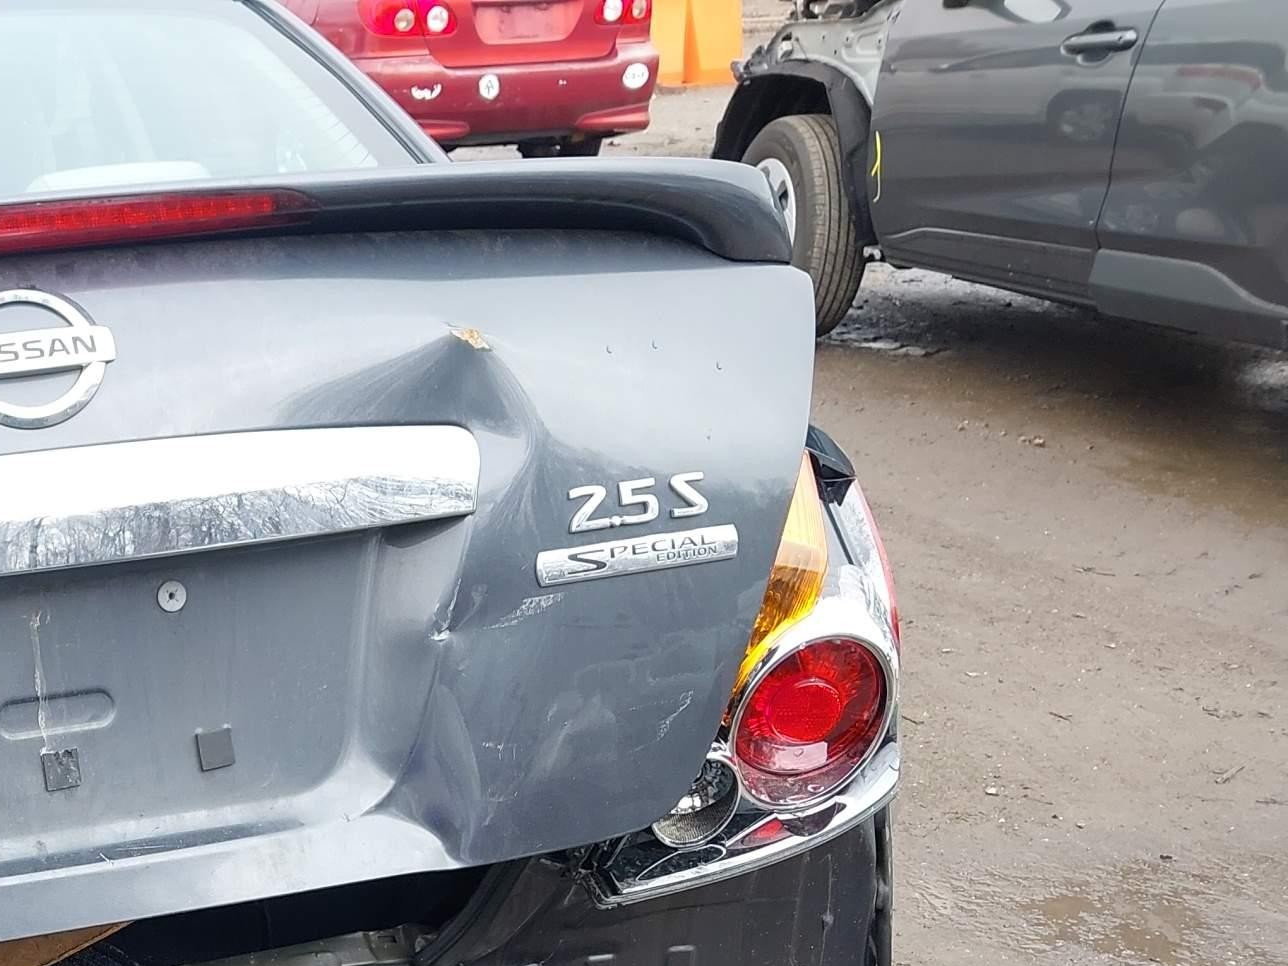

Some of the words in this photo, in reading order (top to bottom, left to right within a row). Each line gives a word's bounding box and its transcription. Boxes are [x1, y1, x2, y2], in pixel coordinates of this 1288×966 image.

[568, 477, 660, 533] 2.5
[669, 471, 709, 518] S
[567, 534, 716, 575] SPECIAL
[656, 545, 718, 563] EDITION
